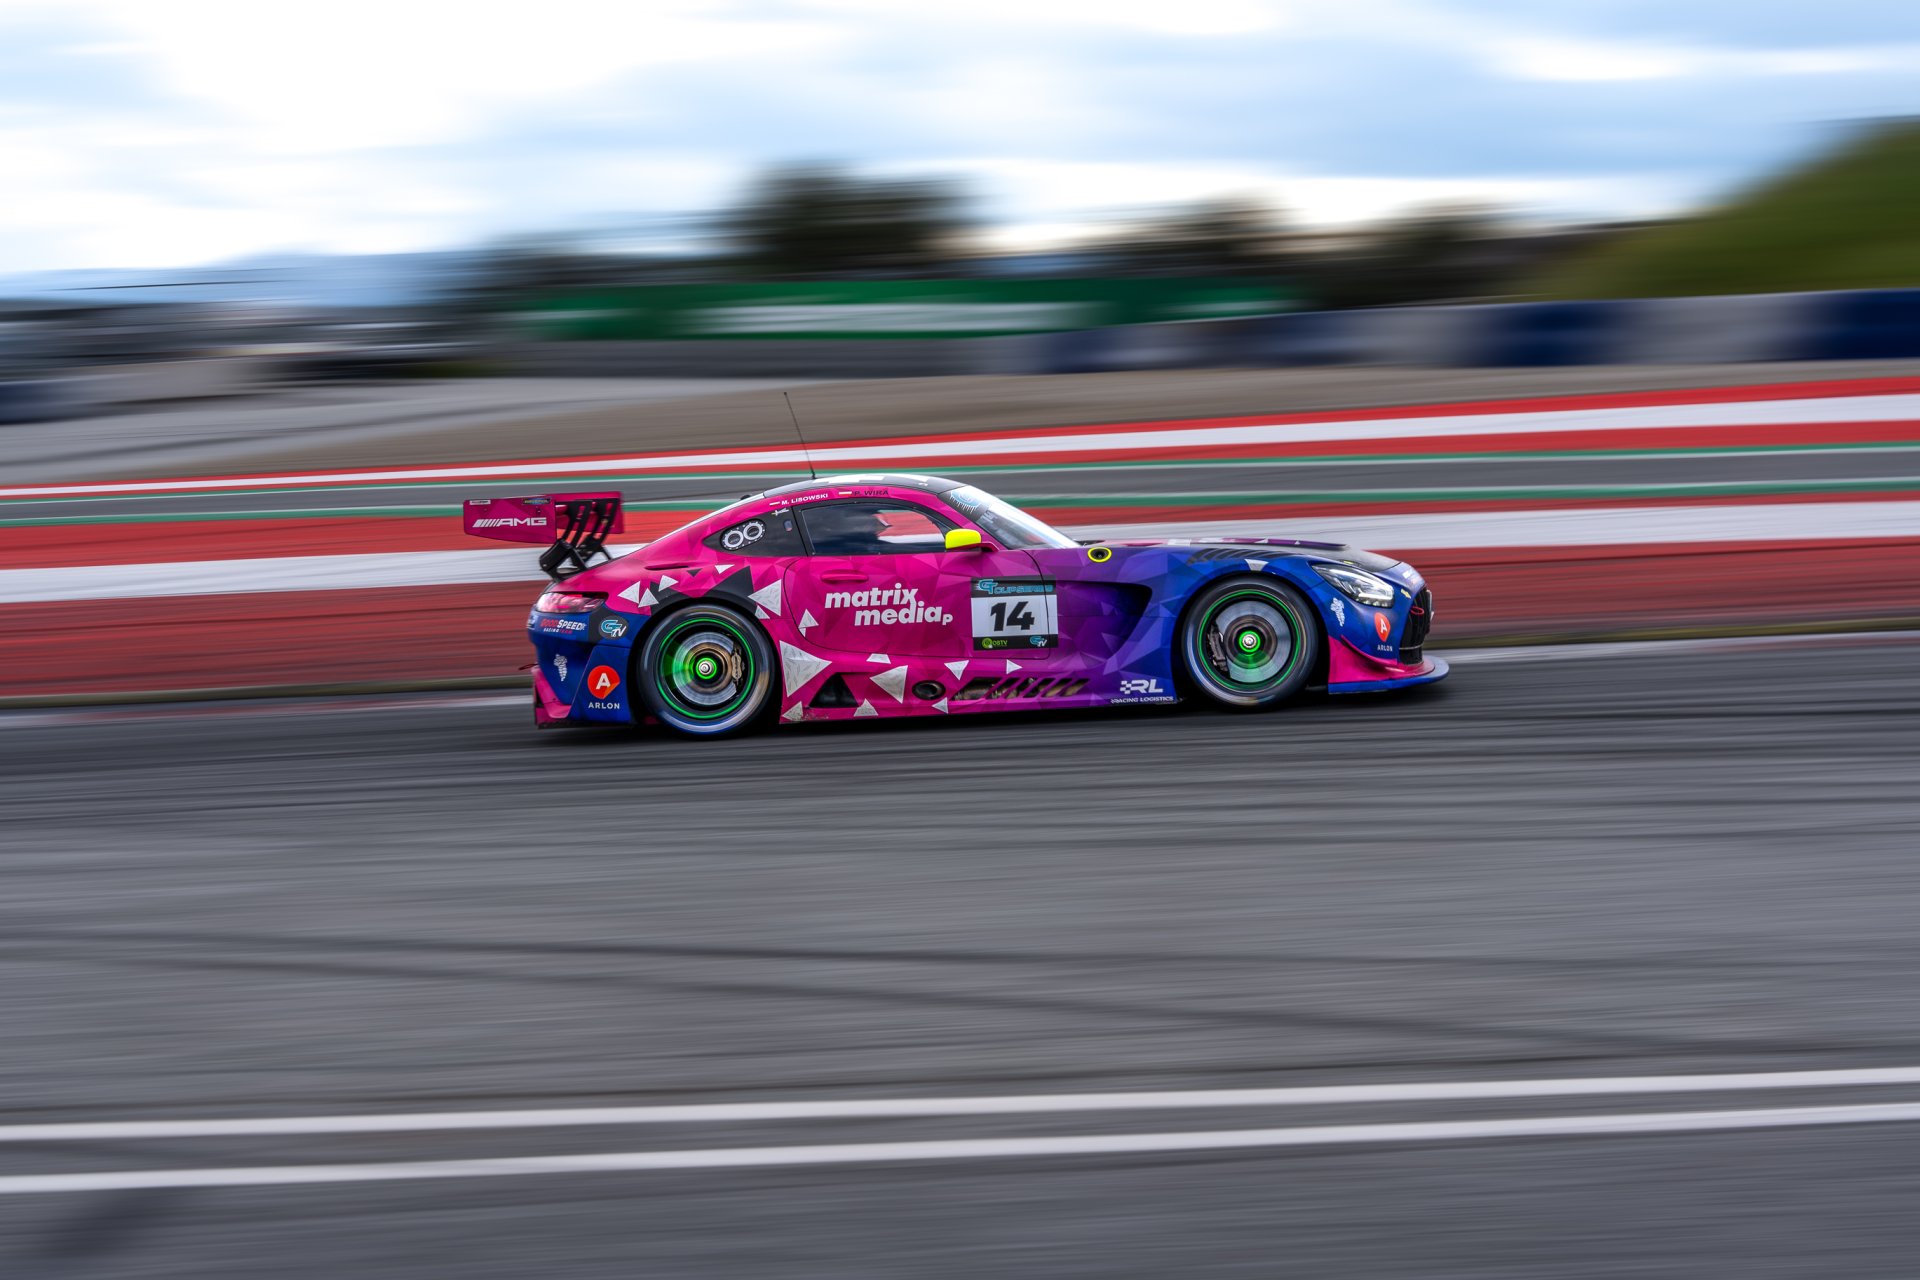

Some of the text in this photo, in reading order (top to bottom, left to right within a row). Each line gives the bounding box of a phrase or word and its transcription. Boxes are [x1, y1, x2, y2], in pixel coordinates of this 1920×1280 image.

[791, 493, 829, 504] LISOWSKI
[498, 517, 547, 527] AMG
[825, 582, 919, 608] matrix
[990, 601, 1035, 632] 14
[1380, 618, 1388, 634] A
[1377, 644, 1393, 652] ARLON
[595, 672, 611, 690] A
[1131, 679, 1164, 694] RL
[588, 701, 620, 710] ARLON
